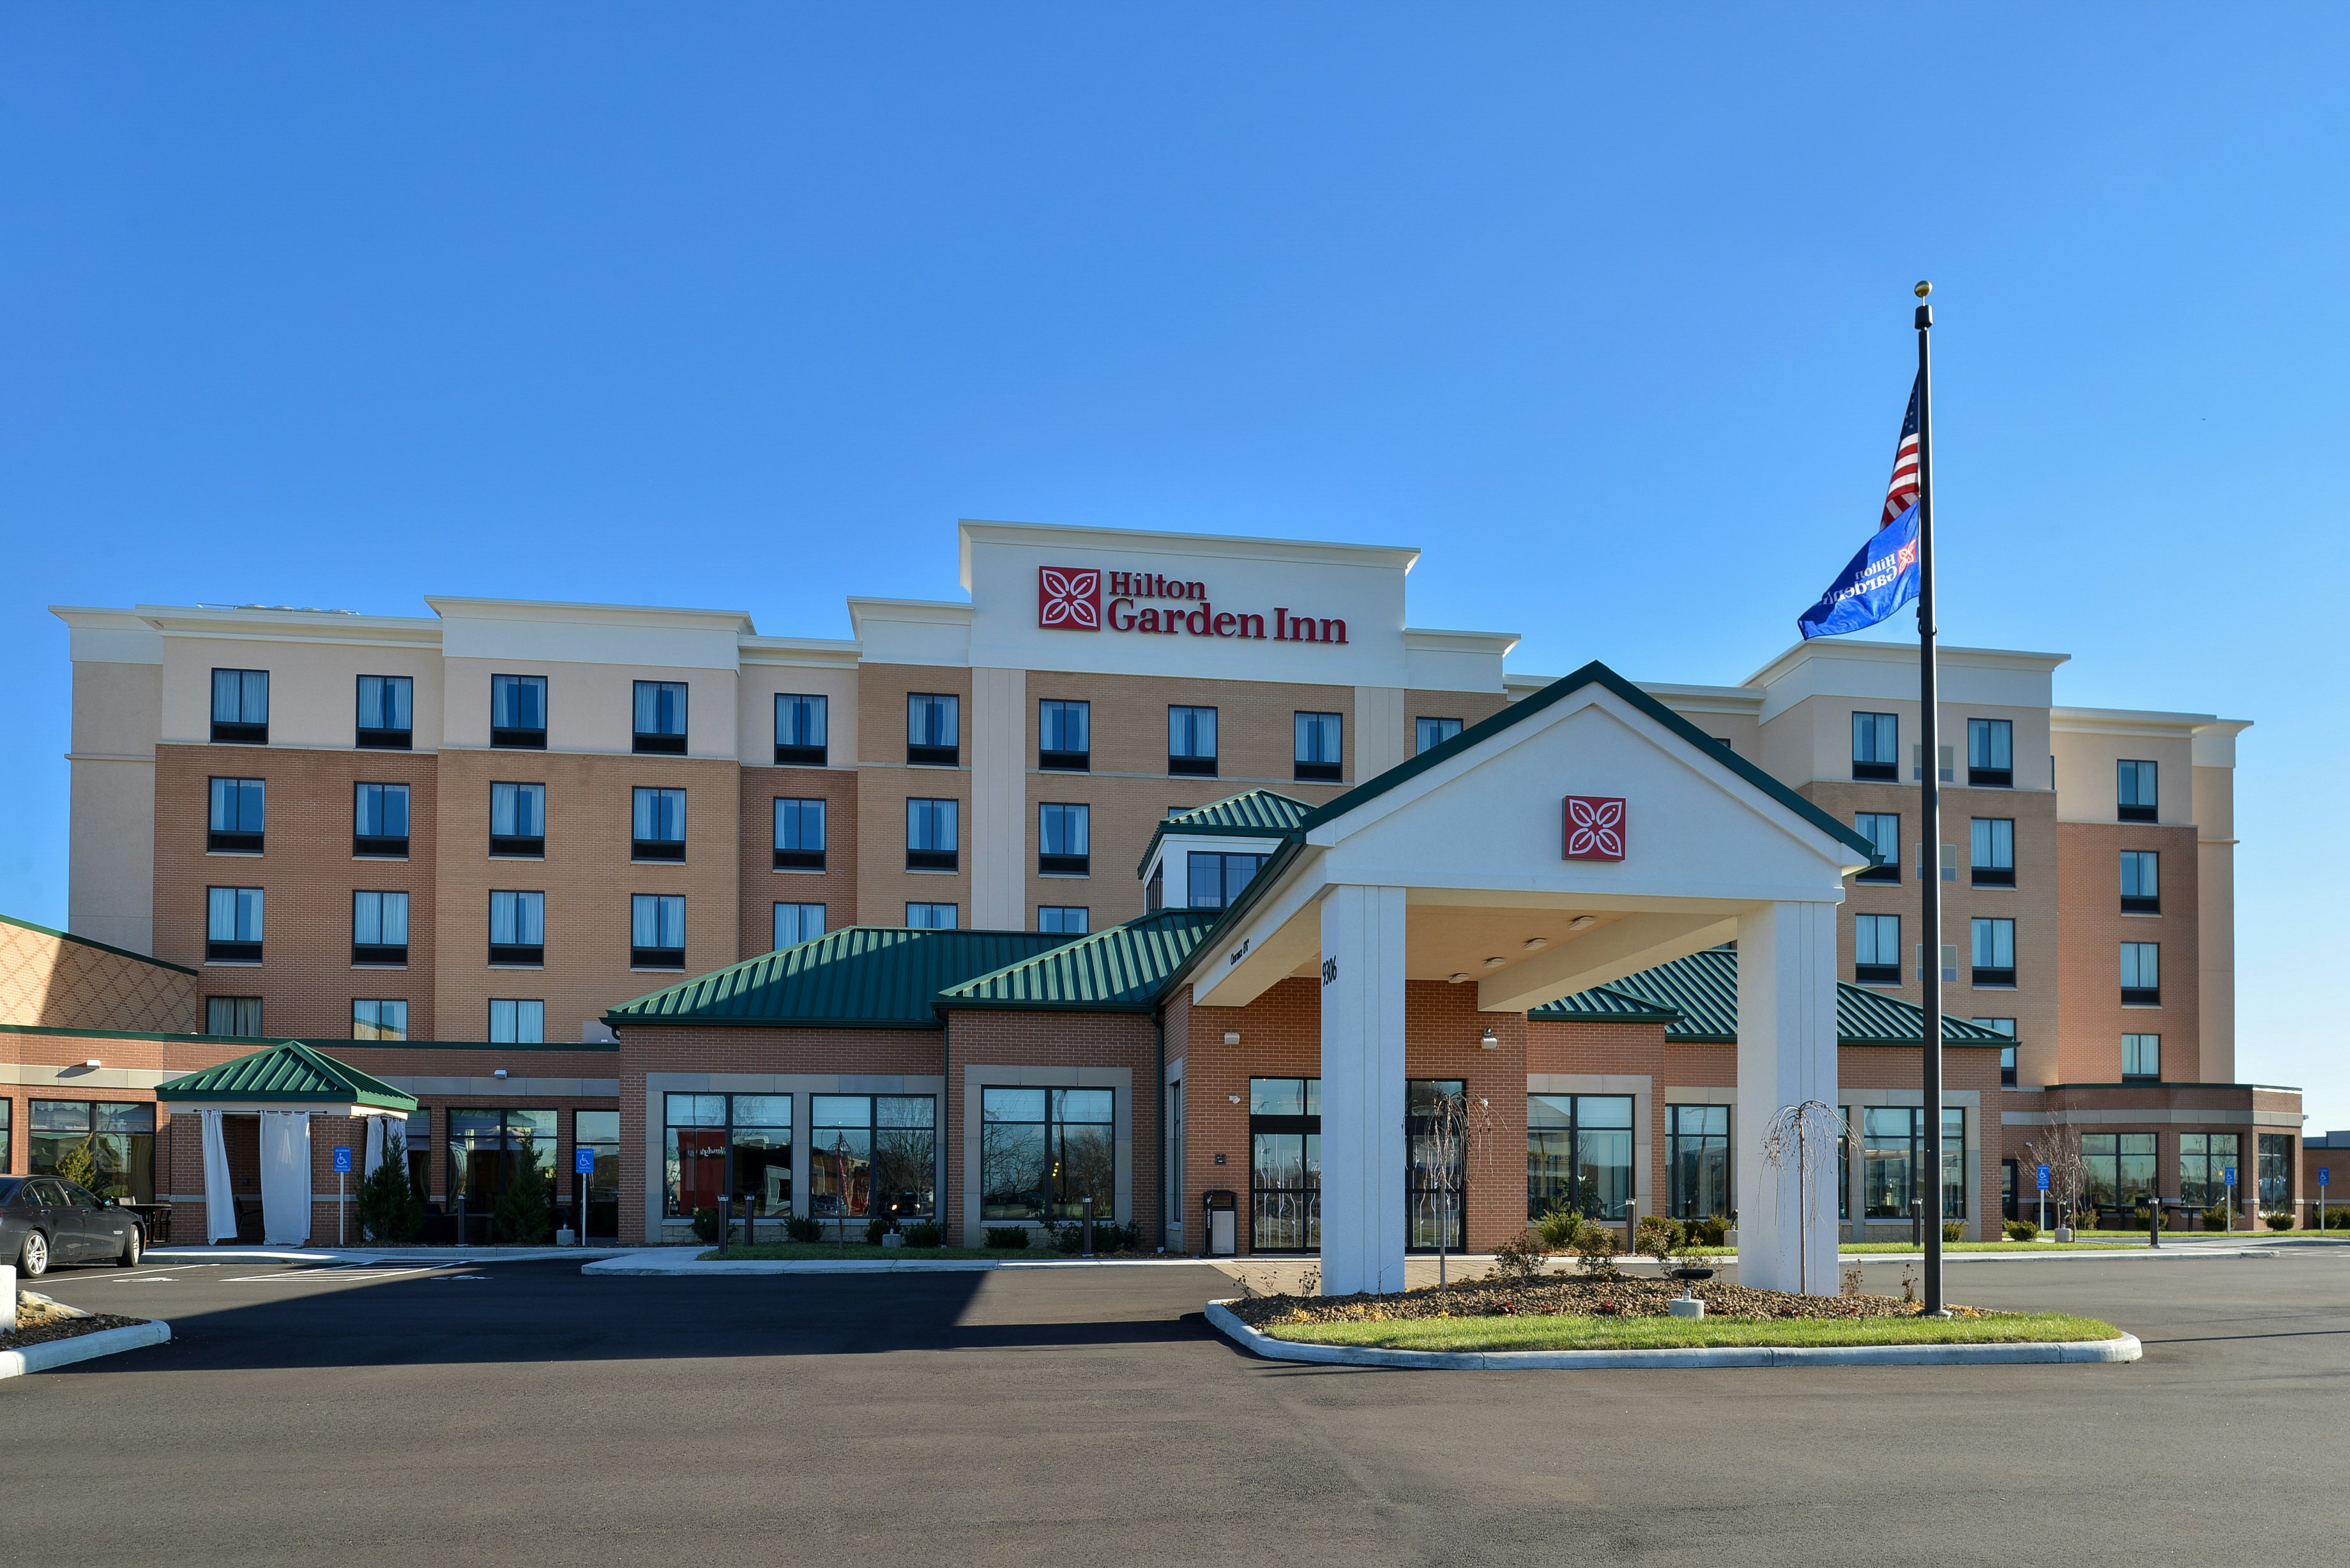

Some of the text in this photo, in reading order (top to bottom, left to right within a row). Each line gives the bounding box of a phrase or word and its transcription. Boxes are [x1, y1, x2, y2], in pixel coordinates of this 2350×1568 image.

[1109, 571, 1207, 600] Hilton
[1107, 597, 1349, 644] Garden Inn
[1323, 954, 1337, 987] 9306
